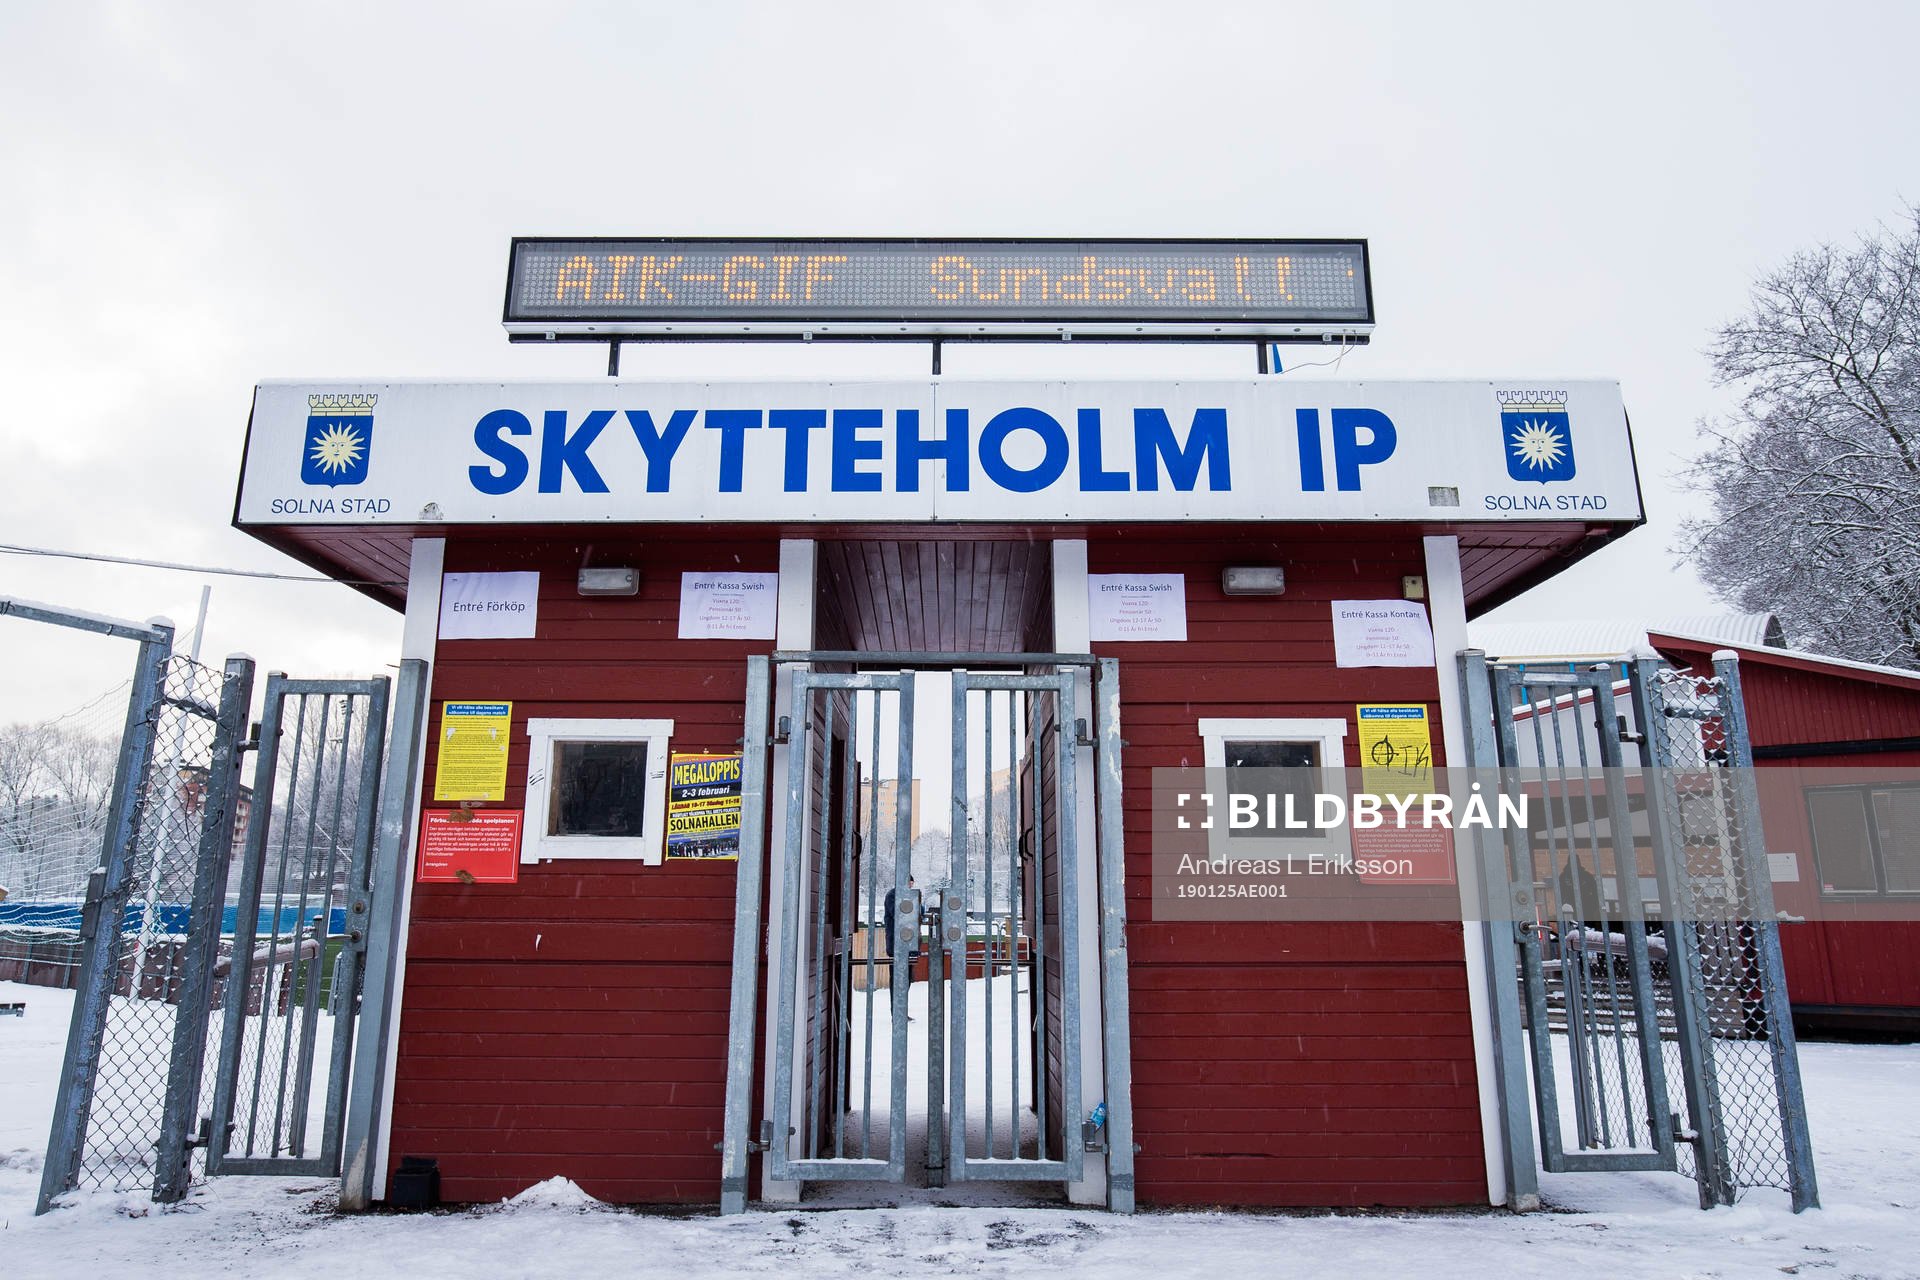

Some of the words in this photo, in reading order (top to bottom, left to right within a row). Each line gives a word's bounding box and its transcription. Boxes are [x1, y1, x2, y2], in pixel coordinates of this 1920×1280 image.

[556, 255, 847, 300] AIK-GIF
[930, 255, 1294, 300] Sundsvall
[469, 407, 1231, 495] SKYTTEHOLM
[1297, 408, 1397, 491] IP
[271, 498, 335, 514] SOLNA
[341, 498, 391, 513] STAD
[1485, 495, 1552, 510] SOLNA
[1556, 495, 1607, 510] STAD
[694, 582, 715, 590] Entré
[717, 582, 740, 590] Kassa
[741, 582, 765, 590] Swish
[1101, 583, 1123, 592] Entré
[1125, 583, 1147, 592] Kassa
[1149, 583, 1172, 592] Swish
[453, 601, 483, 612] Entré
[487, 601, 526, 613] Förköp
[1341, 610, 1364, 619] Entré
[1365, 610, 1388, 618] Kassa
[674, 759, 740, 786] MEGALOPPIS
[681, 788, 696, 798] 2-3
[698, 785, 730, 799] februari
[670, 813, 739, 831] SOLNAHALLEN
